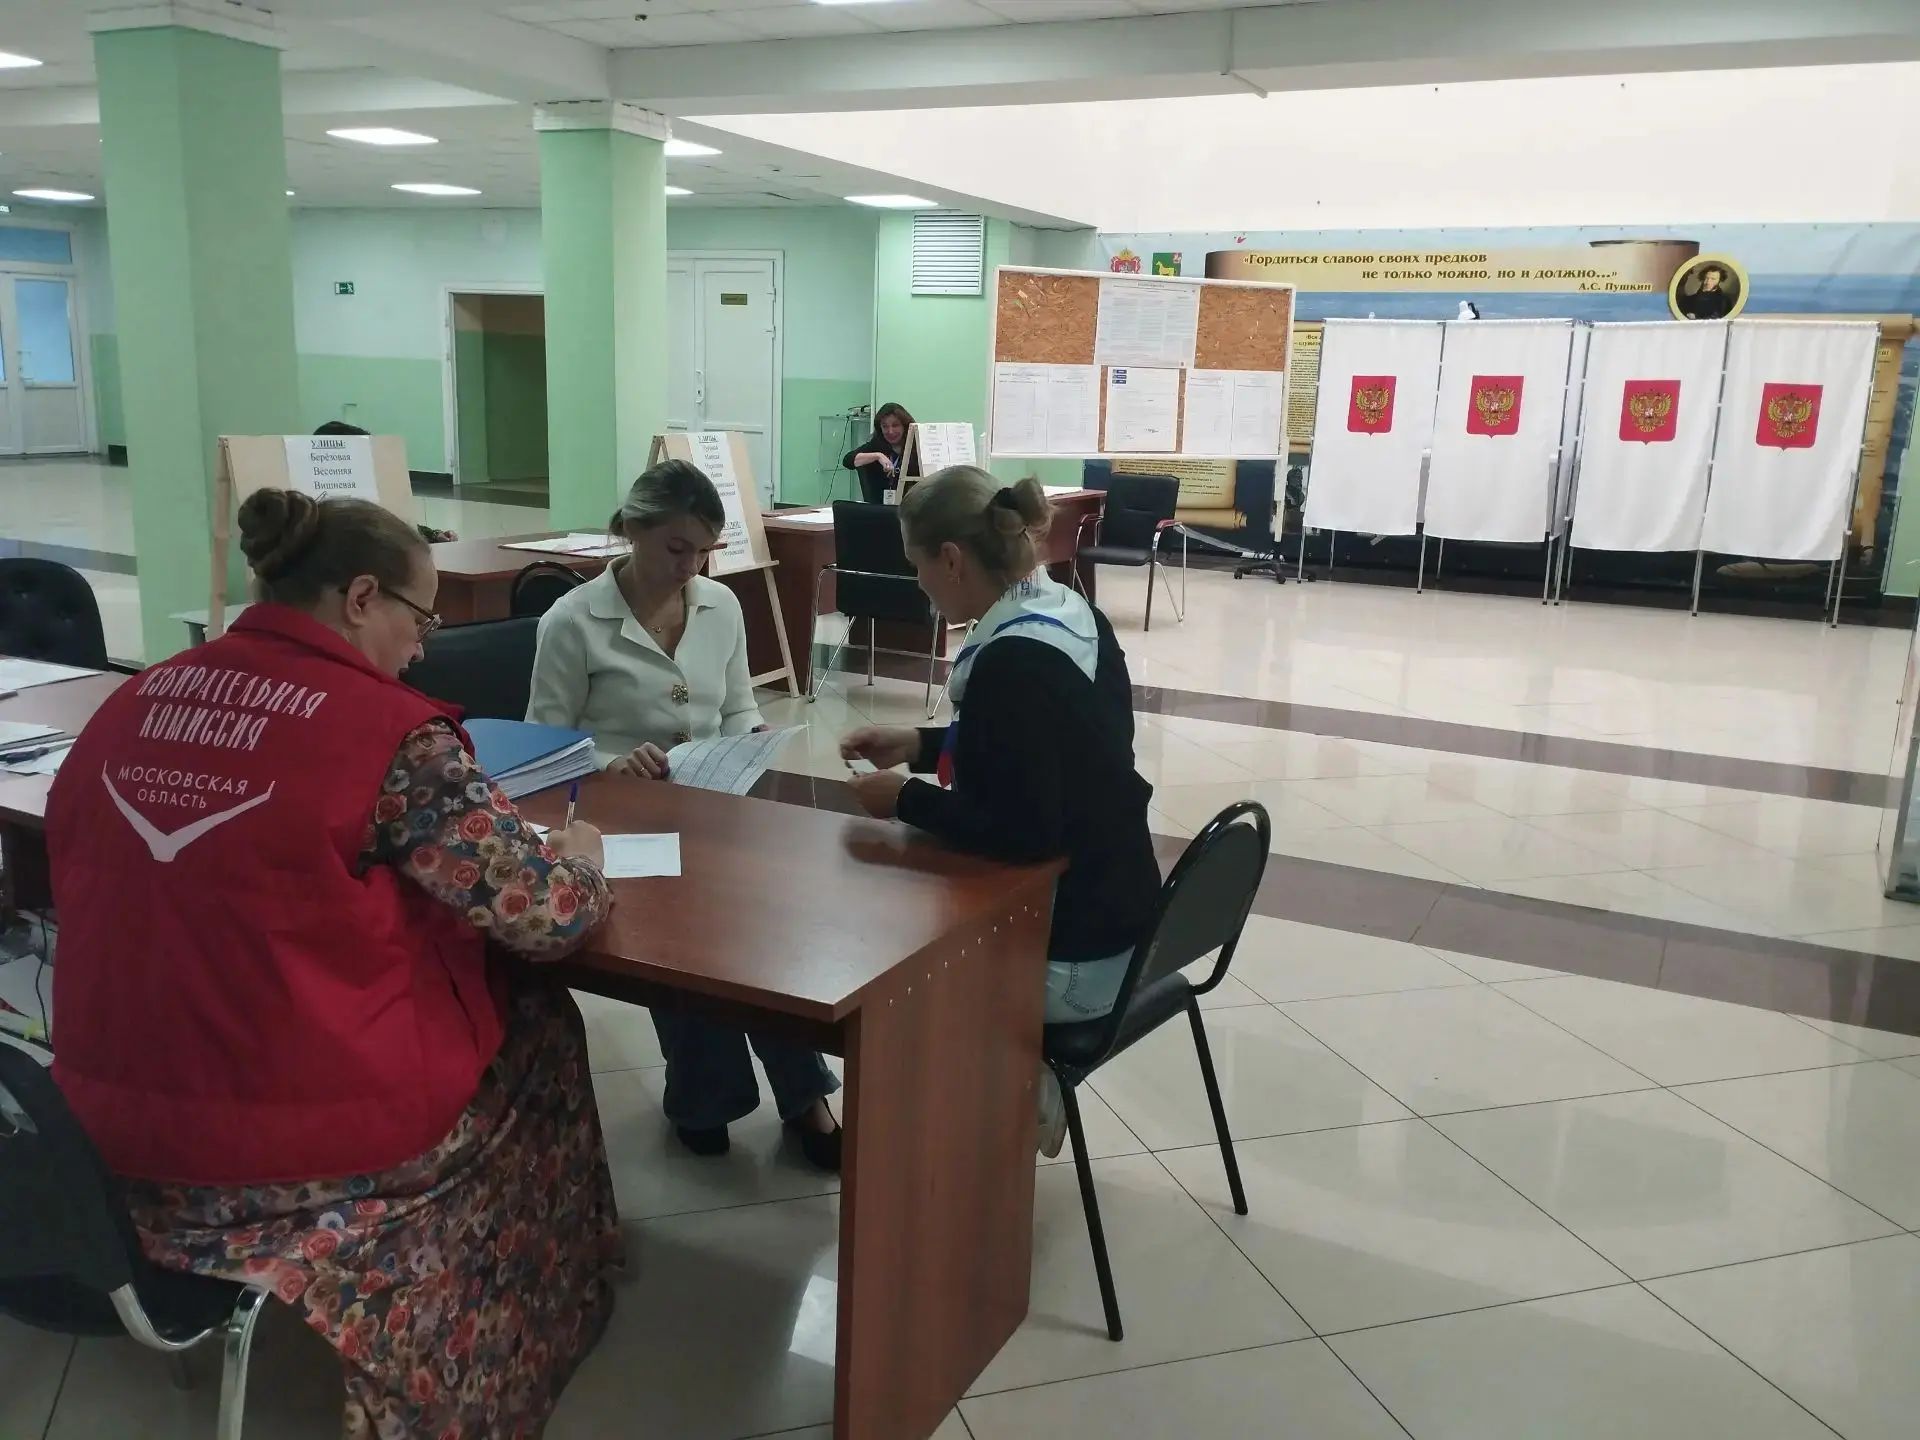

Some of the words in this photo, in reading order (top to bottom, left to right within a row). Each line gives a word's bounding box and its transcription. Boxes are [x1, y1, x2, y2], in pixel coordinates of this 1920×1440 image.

[1322, 253, 1375, 265] славою
[1378, 253, 1420, 264] своих
[1425, 252, 1487, 266] предков
[1362, 269, 1378, 279] не
[1383, 269, 1433, 279] только
[1437, 269, 1491, 280] можно,
[1497, 269, 1516, 279] но
[1520, 269, 1530, 279] и
[1604, 282, 1653, 293] Пушкин
[311, 439, 346, 449] УЛИЦЫ:
[310, 452, 352, 463] Берёзовая
[313, 466, 352, 476] Весенняя
[136, 664, 328, 719] ИЗБИРАТЕЛЬНАЯ
[138, 702, 269, 751] КОМИССИЯ
[117, 764, 249, 796] МОСКОВСКАЯ
[136, 788, 207, 810] ОБЛАСТЬ
